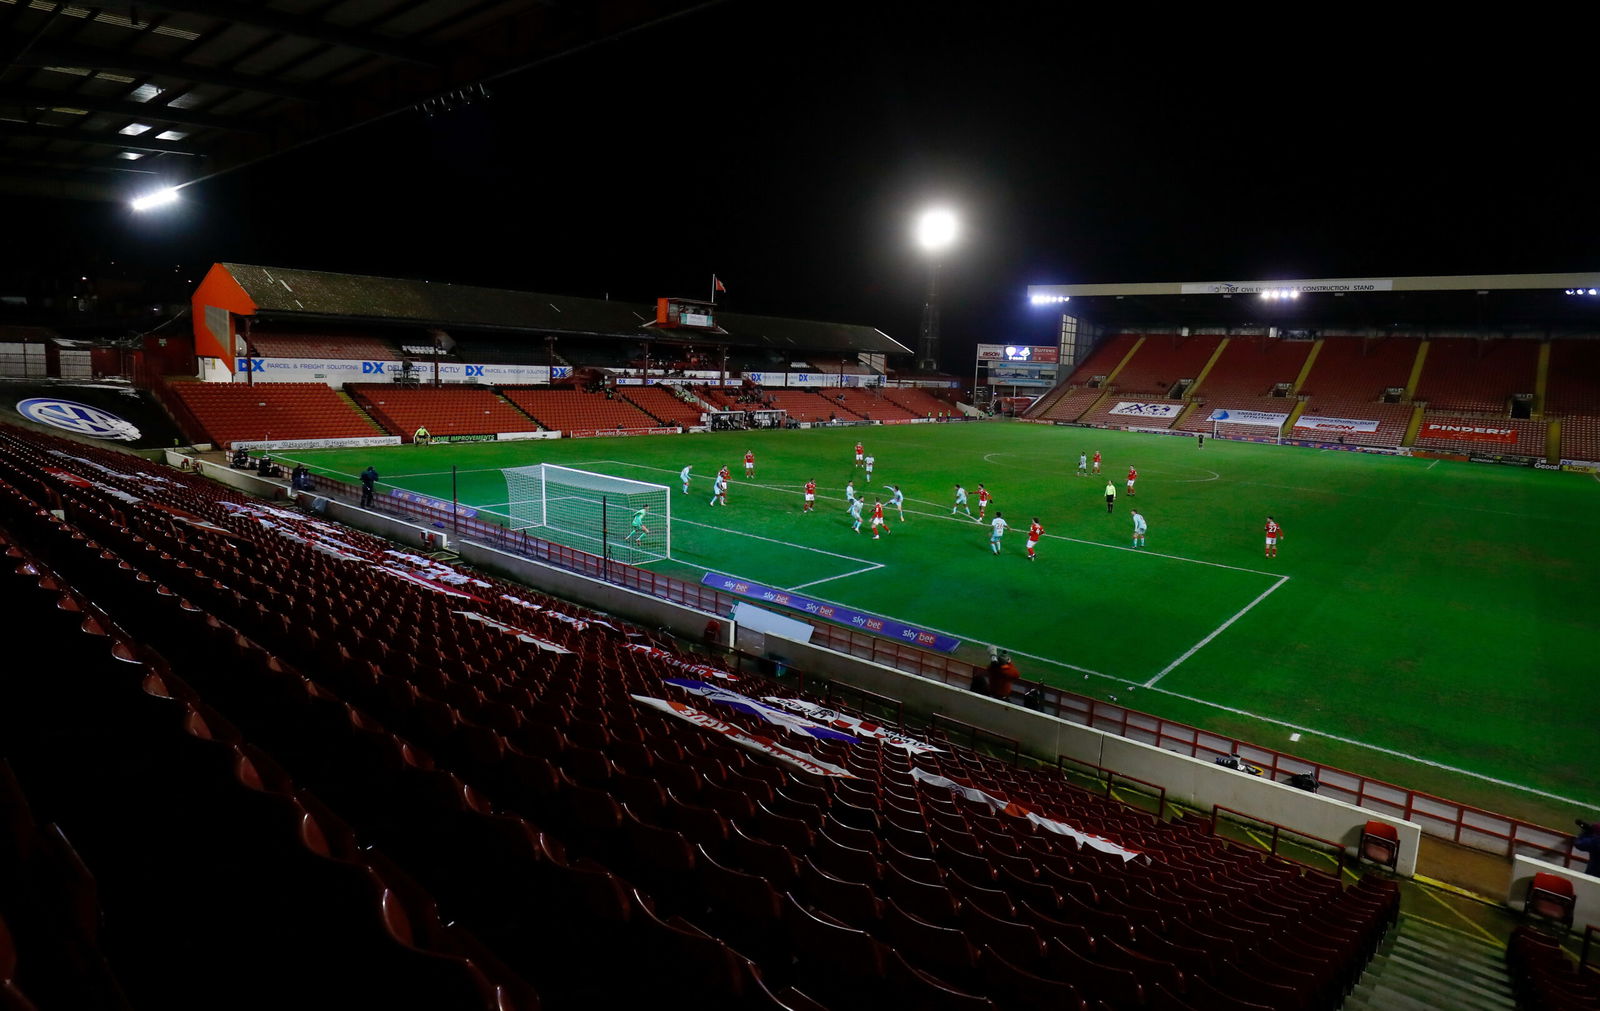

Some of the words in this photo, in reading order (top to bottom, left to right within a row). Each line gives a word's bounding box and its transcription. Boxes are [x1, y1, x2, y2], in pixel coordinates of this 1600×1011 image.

[238, 359, 265, 372] DX
[362, 362, 385, 374] DX
[387, 365, 428, 373] DELRED
[430, 365, 461, 373] EACTLY
[465, 365, 485, 376] DX
[552, 367, 568, 378] DX
[751, 373, 762, 382] DX
[799, 374, 808, 382] DX
[1269, 523, 1277, 531] 27
[724, 580, 736, 590] sky
[735, 583, 748, 592] bet
[763, 591, 776, 600] sky
[776, 594, 788, 604] bet
[806, 602, 820, 613] sky
[820, 605, 833, 616] bet
[852, 615, 866, 626] sky
[866, 619, 881, 630] bet
[902, 629, 917, 640] sky
[919, 632, 934, 643] bet
